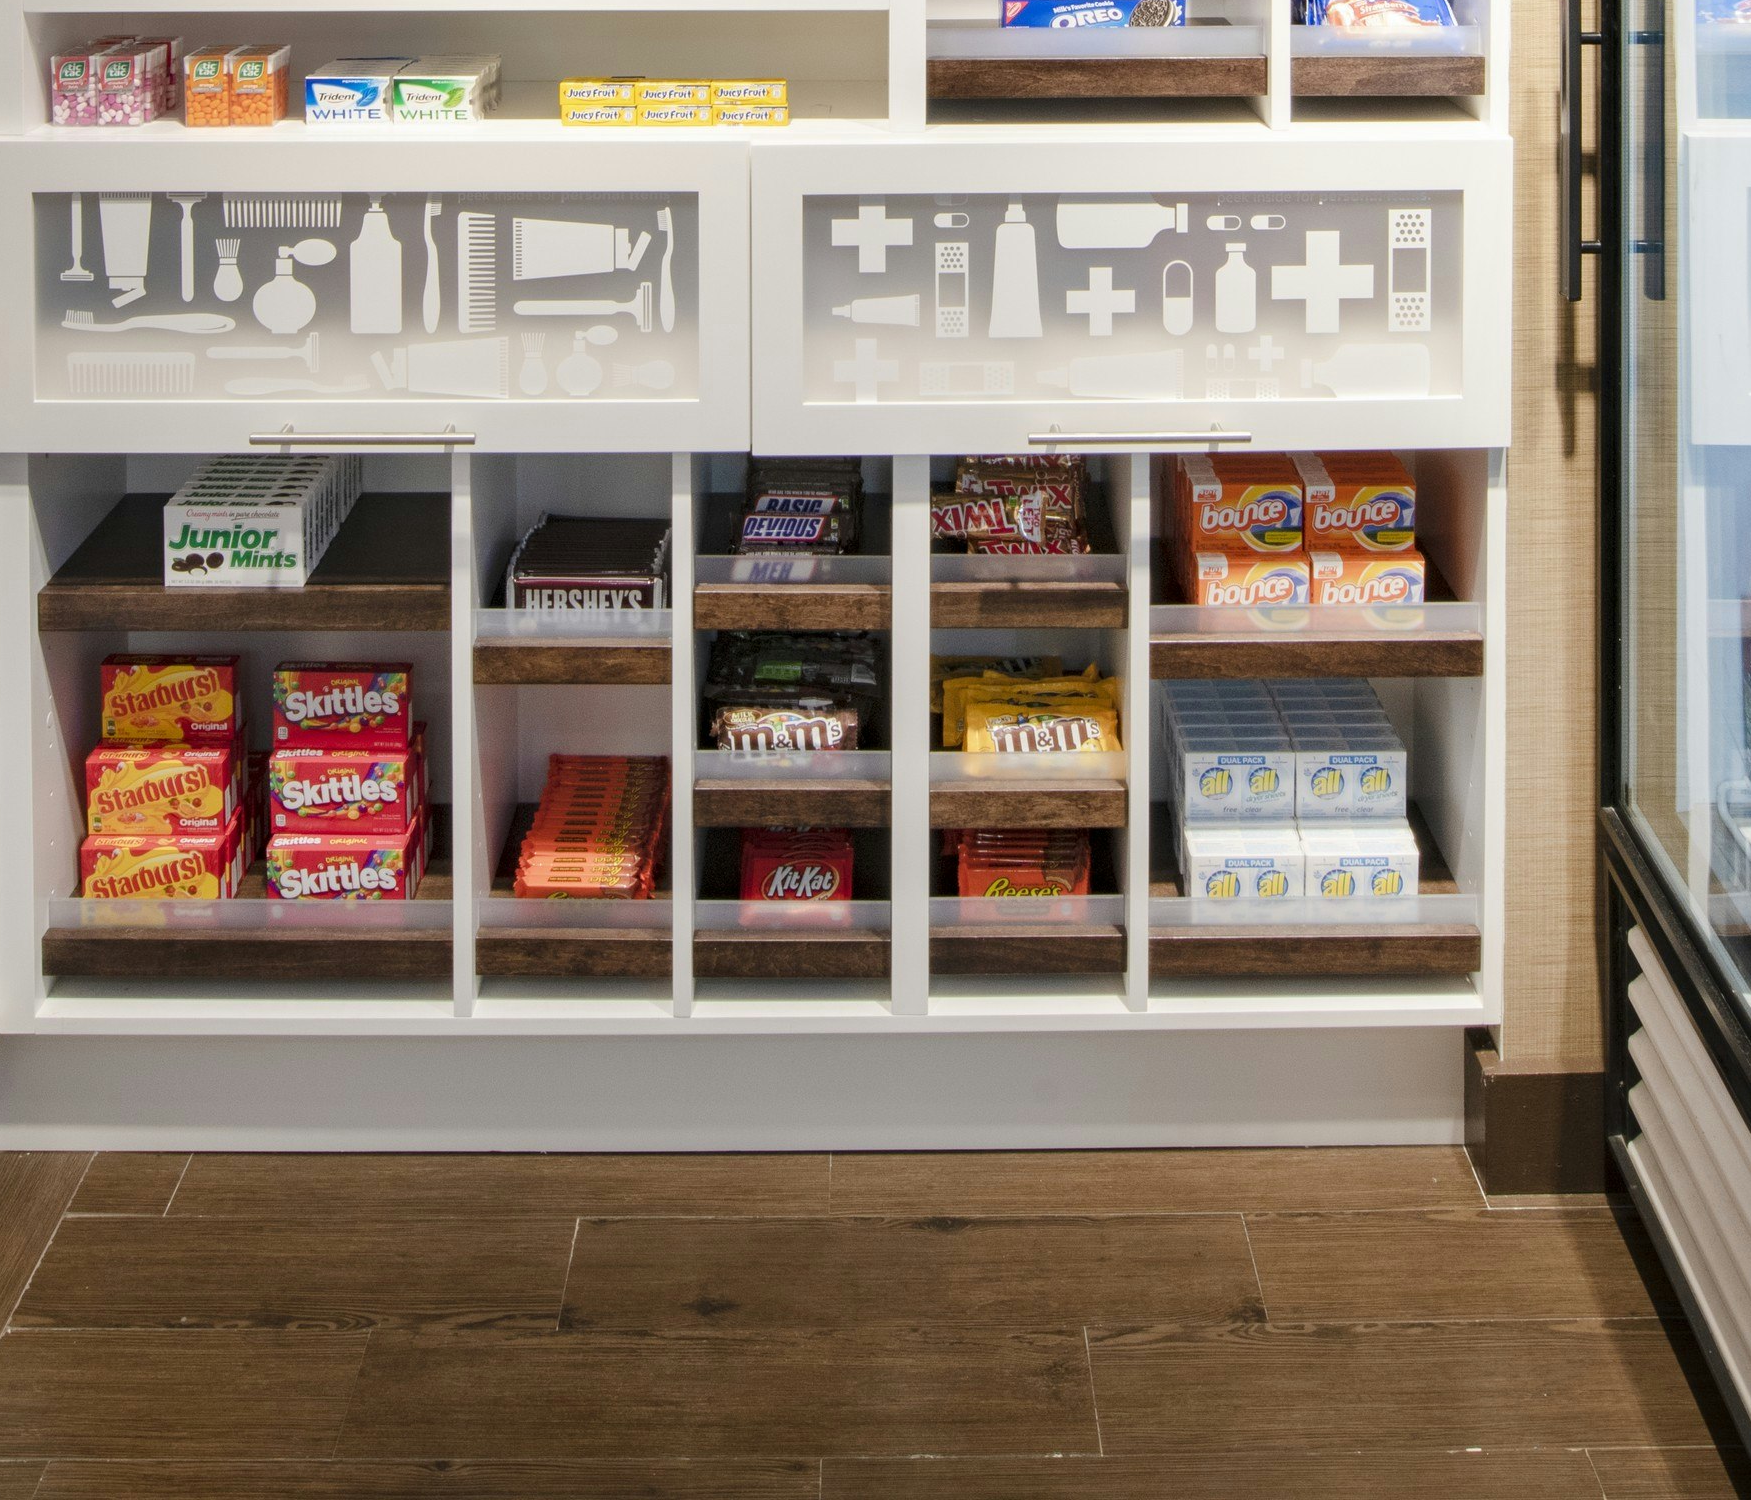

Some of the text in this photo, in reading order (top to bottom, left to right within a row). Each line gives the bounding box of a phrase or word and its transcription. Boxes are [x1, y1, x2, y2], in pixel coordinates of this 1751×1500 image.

[1360, 1, 1408, 14] Strawberry
[1052, 9, 1123, 28] OREO
[319, 93, 355, 101] Trident
[407, 93, 441, 101] Trident
[567, 89, 615, 99] Juicy Fruit
[643, 90, 691, 99] Juicy Fruit
[717, 88, 766, 98] Juicy Fruit
[313, 109, 381, 119] WHITE
[400, 110, 467, 120] WHITE
[570, 111, 617, 121] Juicy Fruit
[644, 110, 693, 120] Juicy Fruit
[720, 112, 768, 121] Juicy Fruit
[186, 509, 211, 521] Creamy
[235, 512, 250, 520] pure
[931, 499, 1018, 536] TWIX
[1201, 500, 1286, 530] bounce
[1314, 501, 1398, 531] bounce
[169, 524, 278, 549] Junior
[744, 517, 820, 537] DEVIOUS
[230, 550, 297, 568] Mints
[1206, 576, 1294, 605] bounce
[1322, 577, 1408, 605] bounce
[110, 669, 217, 718] Starburst
[285, 686, 398, 722] Skittles
[190, 722, 227, 732] Original
[183, 750, 219, 759] Original
[276, 749, 323, 758] Skittles
[1220, 757, 1265, 765] DUAL PACK
[1332, 757, 1375, 765] DUAL PACK
[97, 765, 209, 816] Starburst
[1201, 769, 1229, 797] all
[1250, 768, 1278, 795] all
[1311, 769, 1341, 797] all
[1362, 768, 1389, 795] all
[283, 774, 396, 809] Skittles
[180, 817, 217, 827] Original
[273, 836, 321, 847] Skittles
[1343, 858, 1387, 866] DUAL PACK
[92, 852, 204, 898] Starburst
[279, 864, 396, 898] Skittles
[1206, 870, 1236, 896] all
[1258, 870, 1286, 896] all
[1320, 870, 1350, 896] all
[1372, 870, 1399, 896] all
